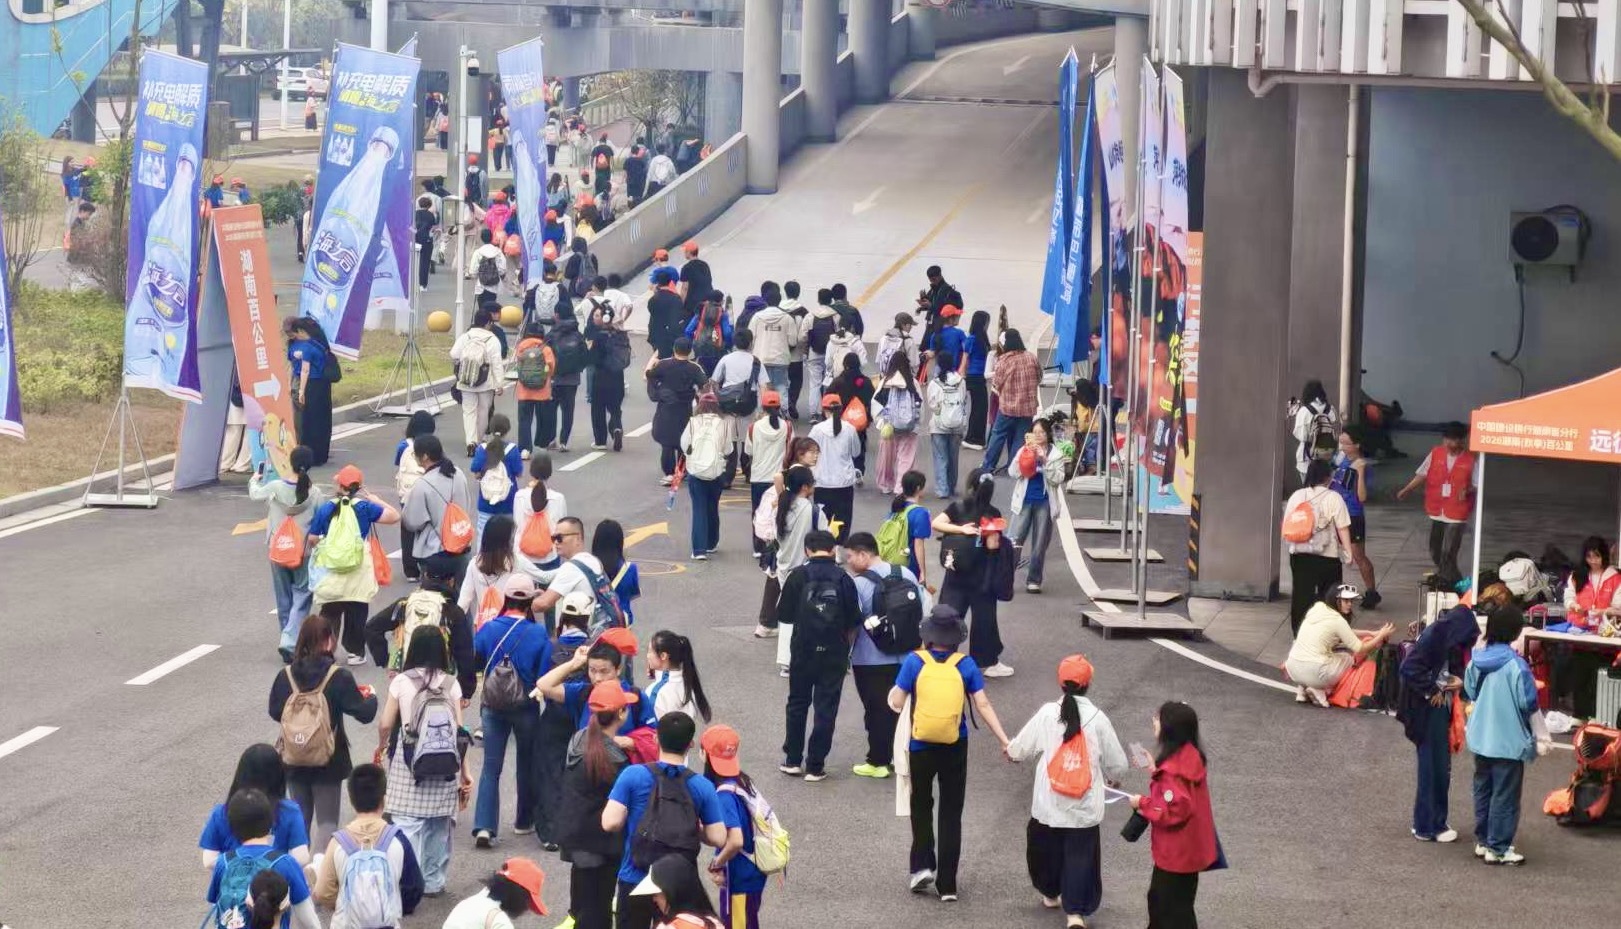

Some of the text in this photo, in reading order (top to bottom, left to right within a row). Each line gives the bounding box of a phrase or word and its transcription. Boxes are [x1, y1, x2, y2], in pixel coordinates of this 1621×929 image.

[142, 80, 203, 108] 补充电解质
[336, 72, 412, 97] 补充电解质
[240, 249, 269, 370] 湖南百公里
